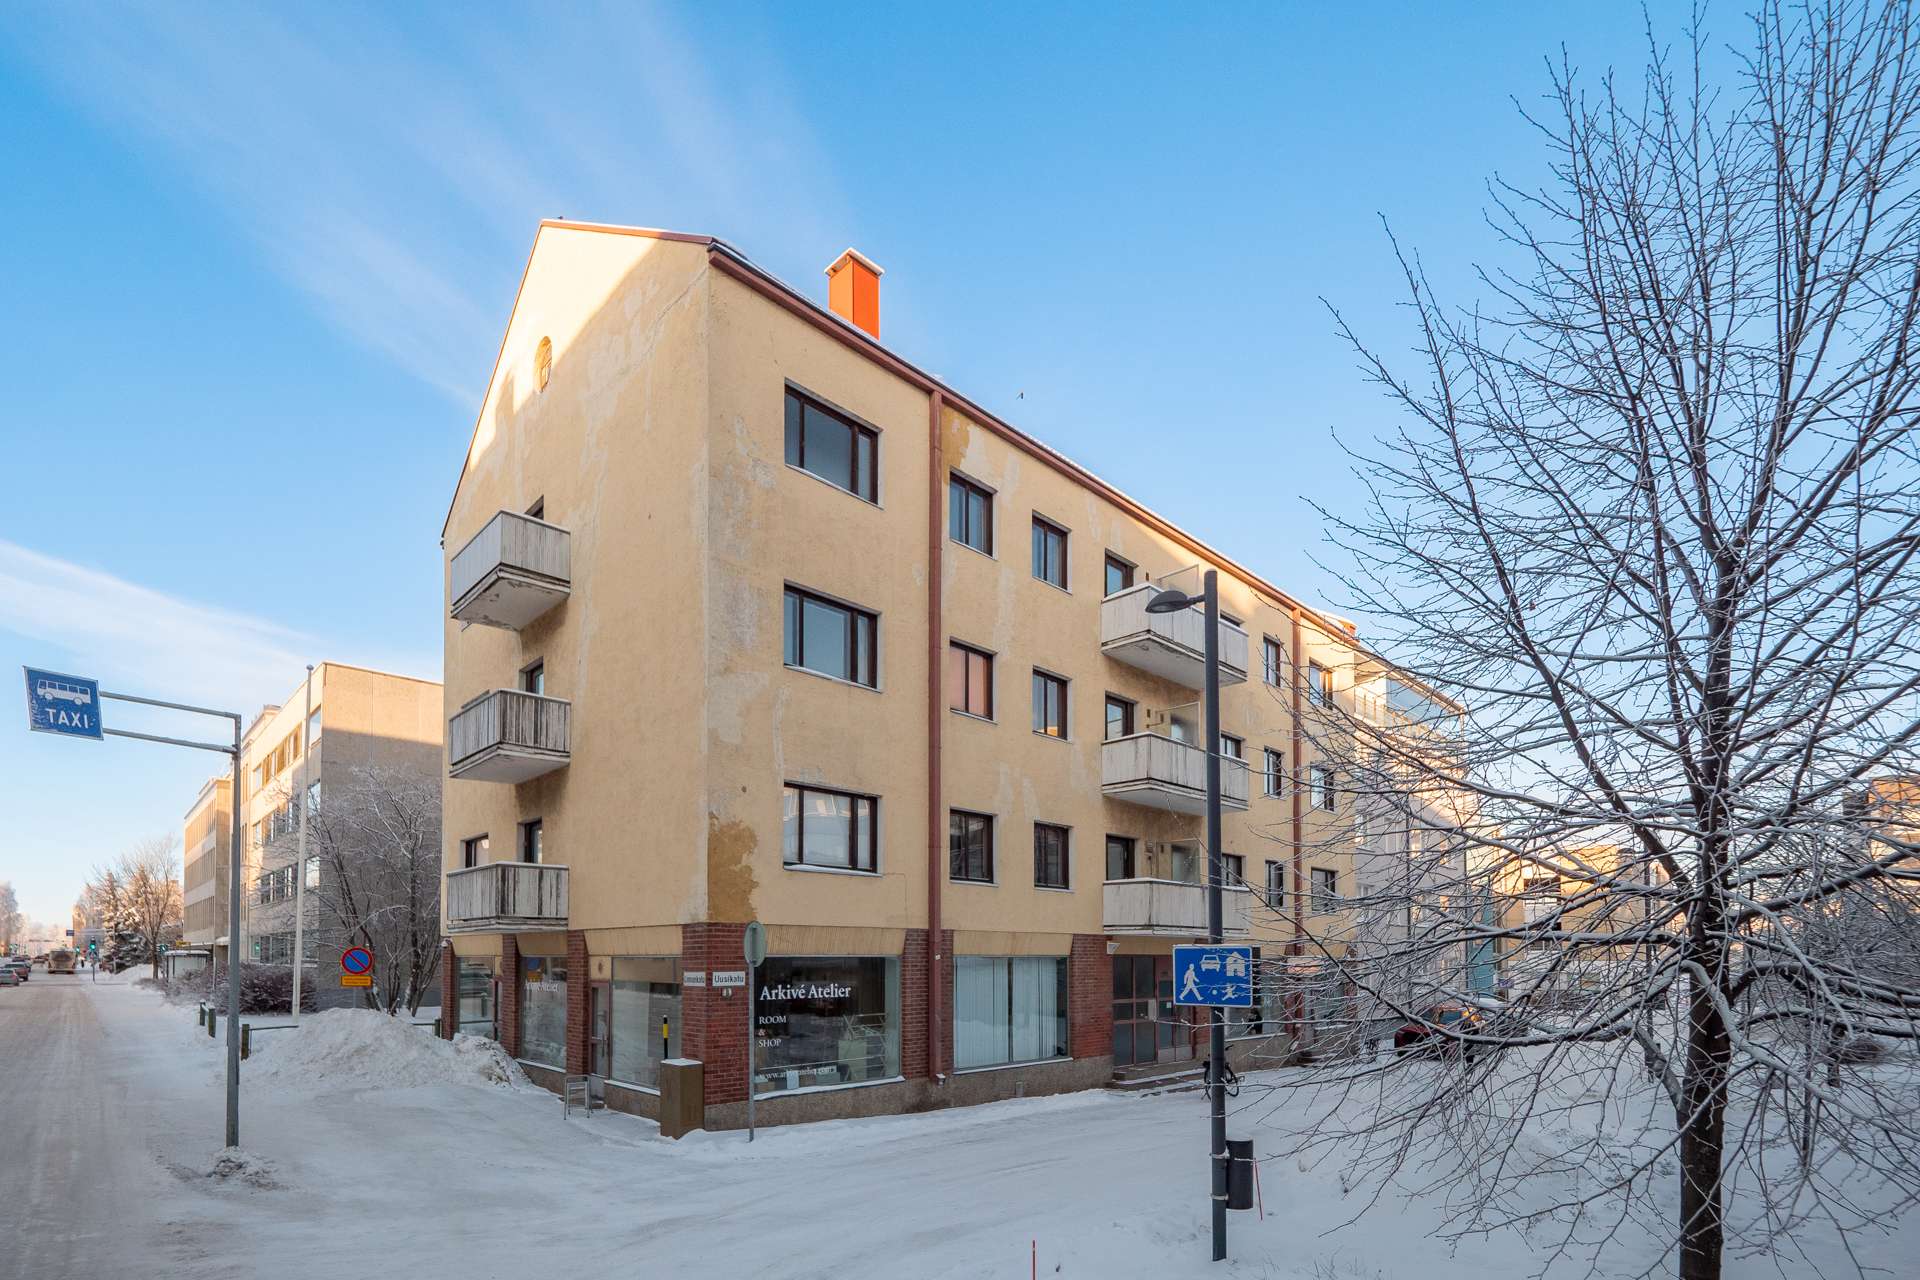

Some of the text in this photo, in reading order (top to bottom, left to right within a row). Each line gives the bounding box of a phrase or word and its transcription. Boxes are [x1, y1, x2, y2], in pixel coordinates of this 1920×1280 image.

[45, 708, 89, 729] TAXI
[714, 975, 744, 983] Uusikatu
[725, 988, 730, 996] 8
[759, 982, 852, 1001] Arkivé Atelier
[758, 1015, 787, 1025] ROOM
[758, 1028, 766, 1036] &
[758, 1038, 782, 1048] SHOP
